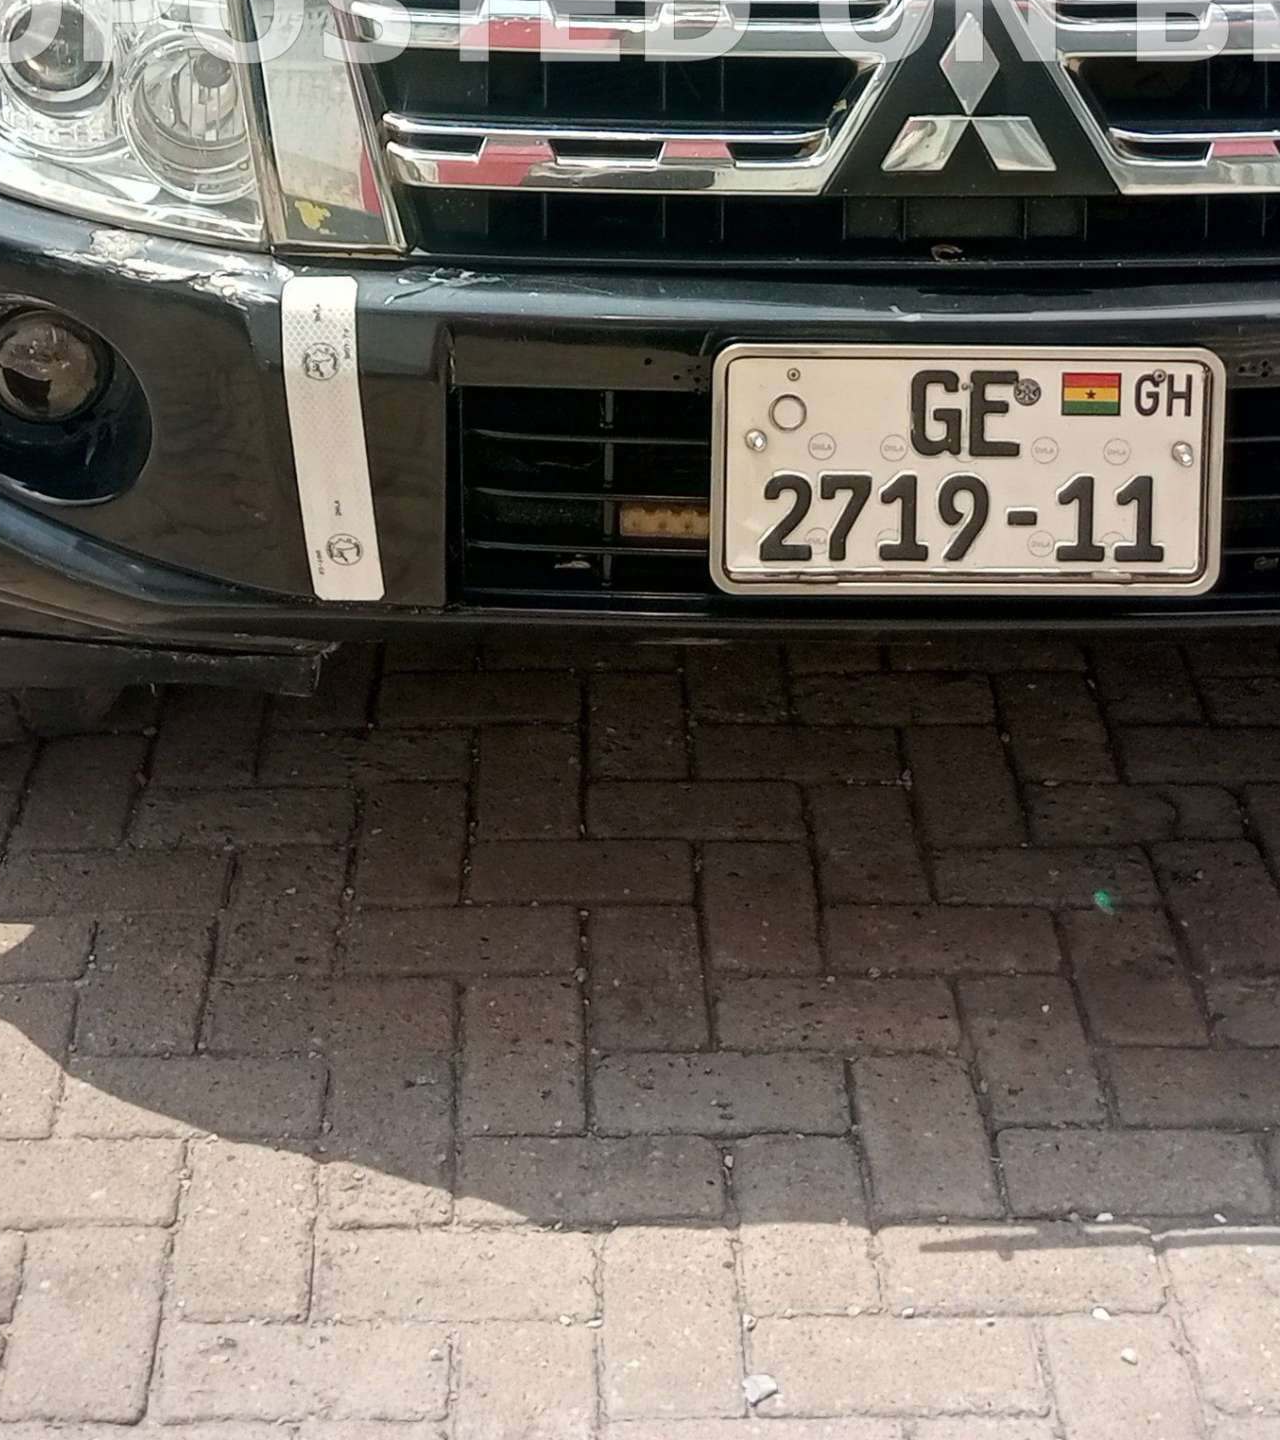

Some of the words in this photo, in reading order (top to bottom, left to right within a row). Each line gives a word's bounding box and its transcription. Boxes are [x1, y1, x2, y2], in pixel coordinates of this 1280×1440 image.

[910, 369, 1021, 457] GE
[1134, 373, 1193, 418] GH
[759, 473, 1165, 563] 2719-11
